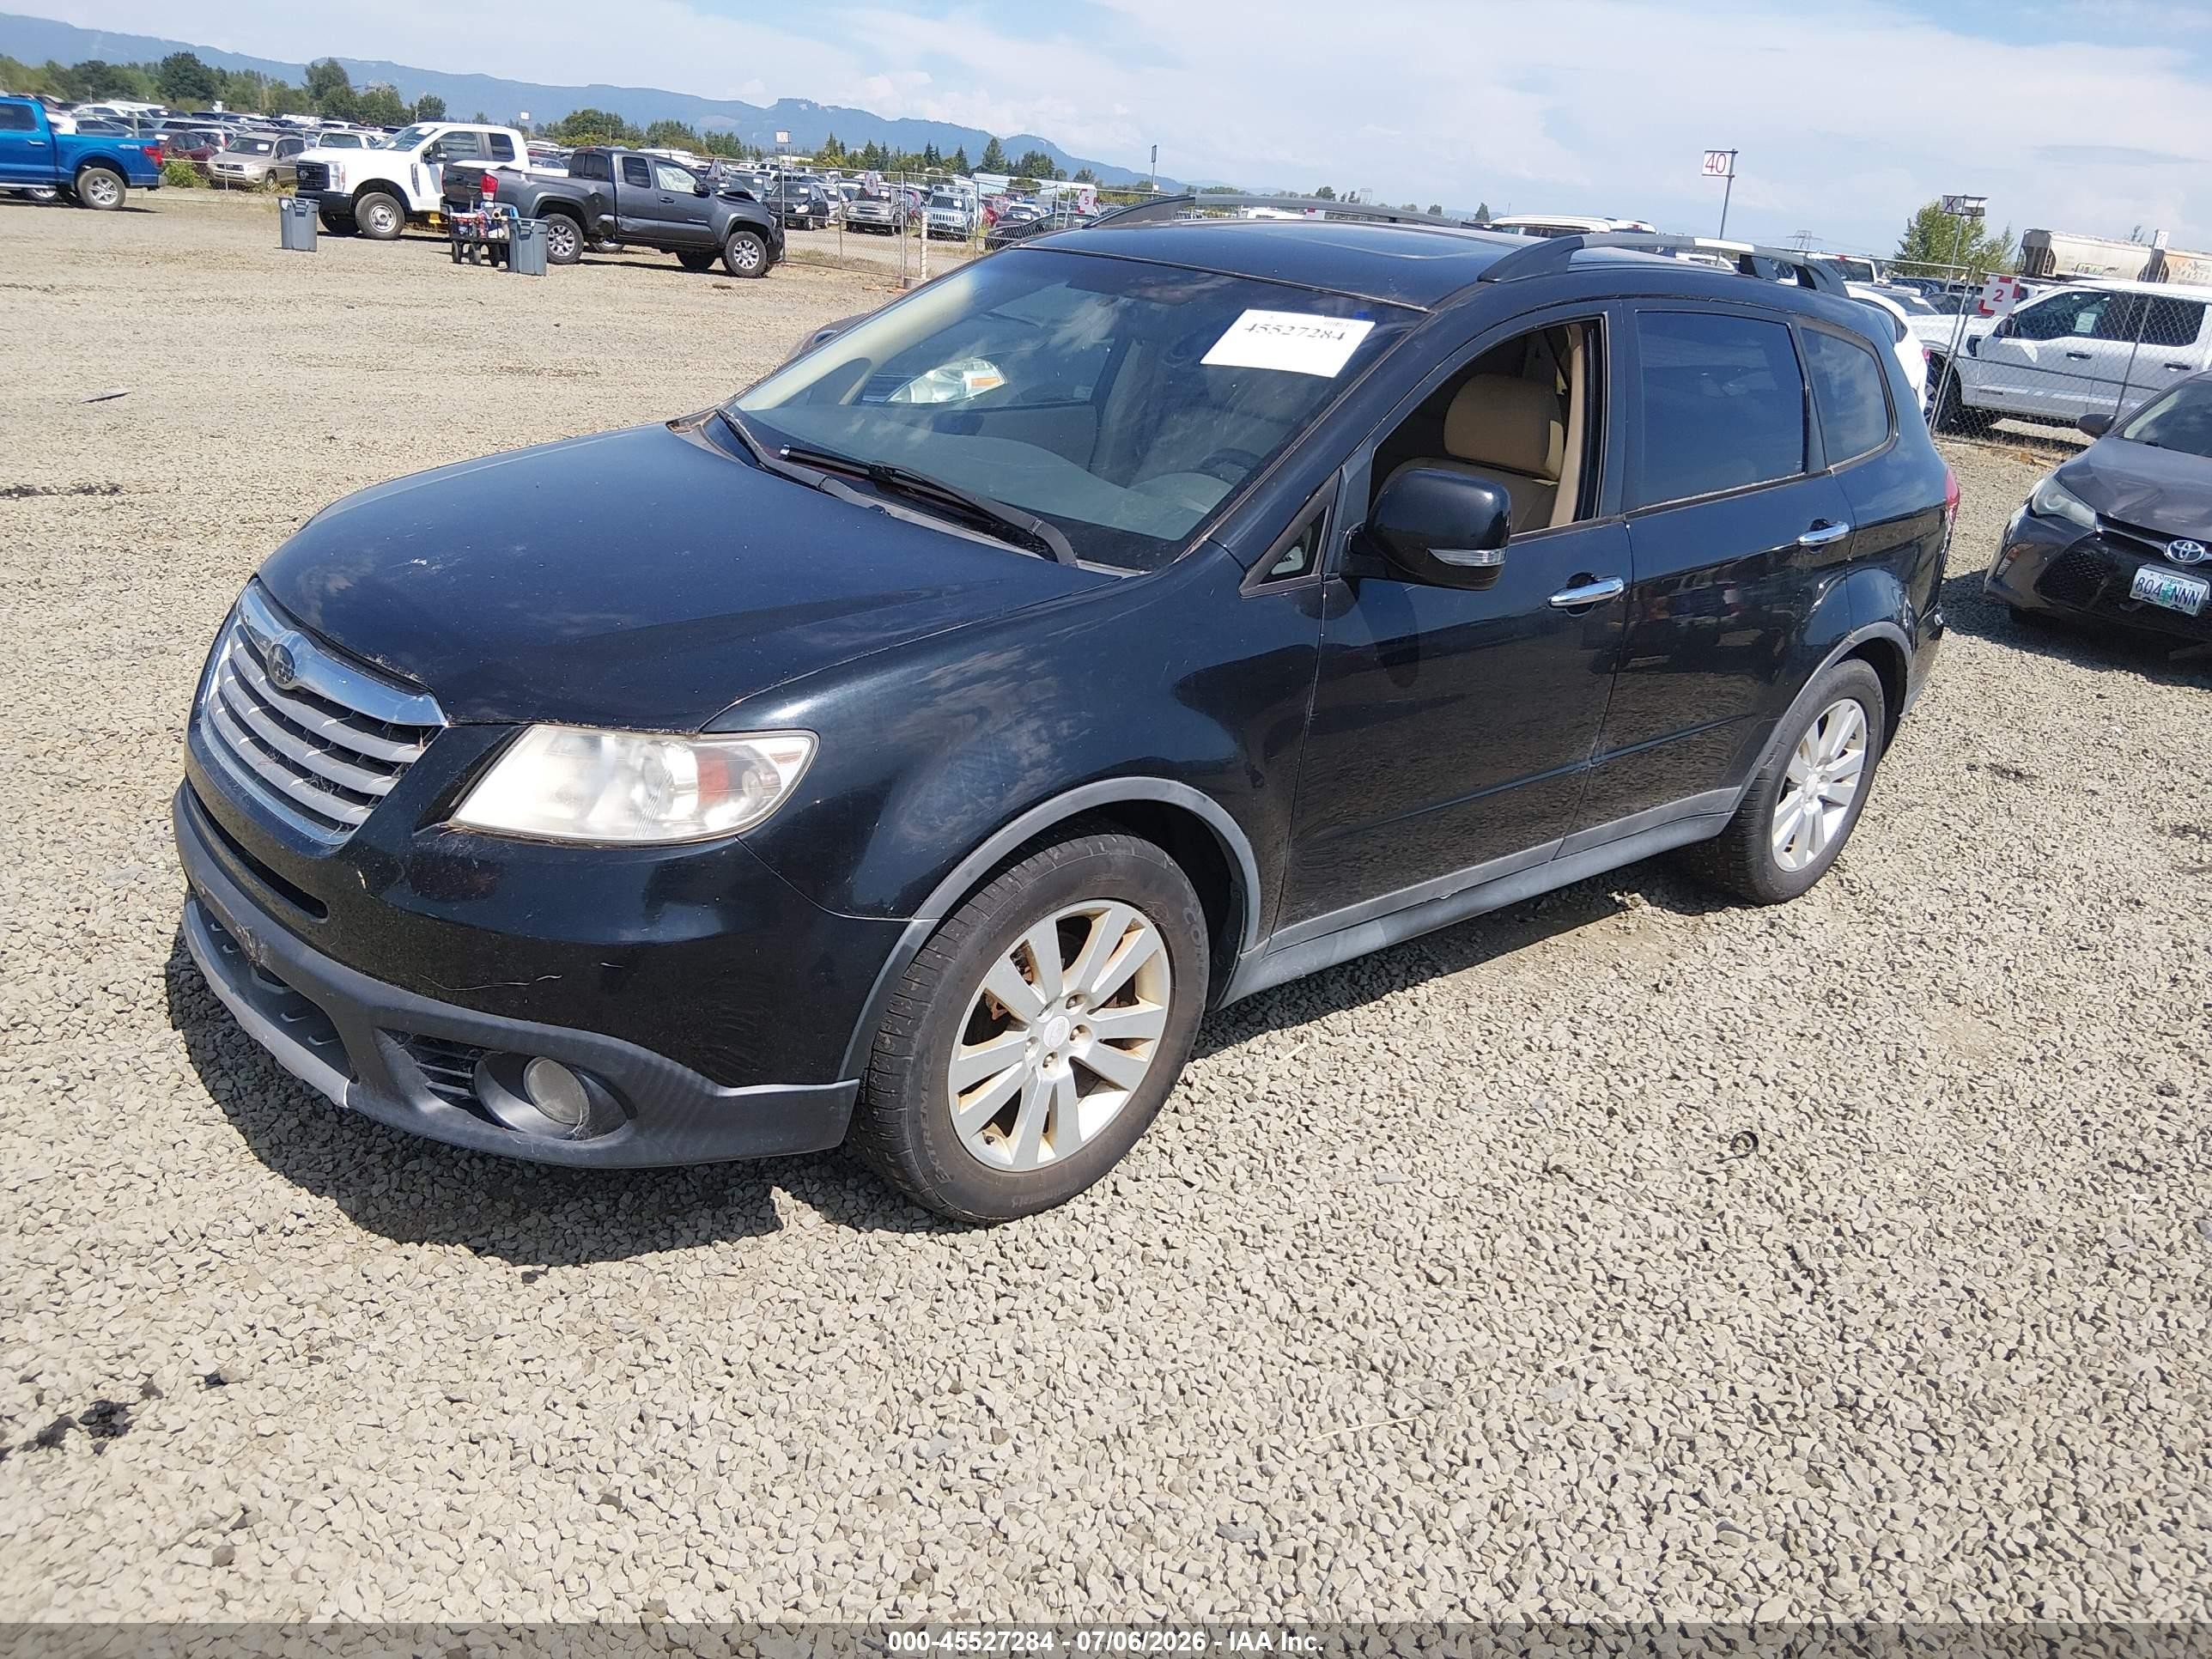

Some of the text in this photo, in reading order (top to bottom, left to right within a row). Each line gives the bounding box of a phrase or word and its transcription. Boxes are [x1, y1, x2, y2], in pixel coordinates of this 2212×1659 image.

[1705, 153, 1727, 174] 40
[1084, 196, 1090, 205] 5
[1943, 198, 1956, 213] K
[1992, 289, 2005, 302] 2
[1244, 323, 1346, 341] 45527284
[2158, 574, 2185, 586] Oregon
[2135, 576, 2200, 608] 804 NNN
